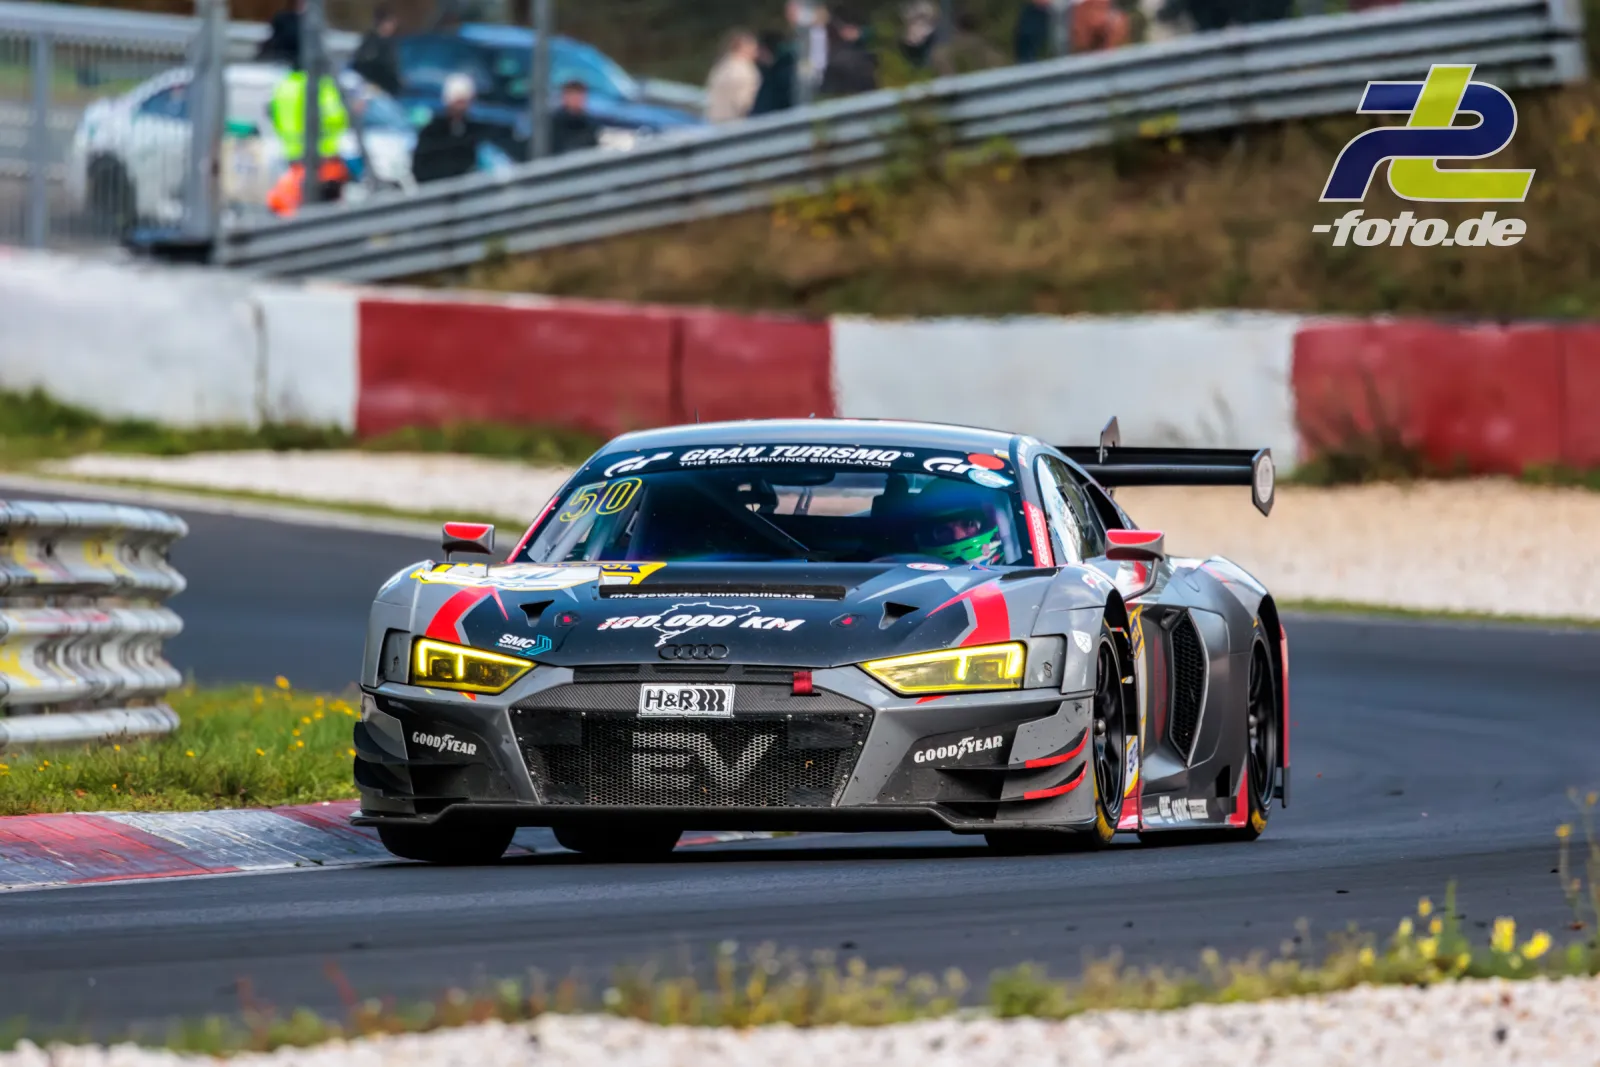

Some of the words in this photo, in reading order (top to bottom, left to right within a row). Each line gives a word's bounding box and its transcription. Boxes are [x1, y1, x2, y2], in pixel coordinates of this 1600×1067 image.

[679, 446, 767, 462] GRAN
[809, 457, 892, 467] SIMULATOR
[559, 477, 643, 523] 50
[597, 614, 737, 630] 100.000
[738, 616, 807, 631] KM
[498, 633, 536, 648] SMC
[644, 688, 697, 709] H&R
[412, 732, 477, 755] GOODYEAR
[914, 735, 1003, 763] GOODYEAR
